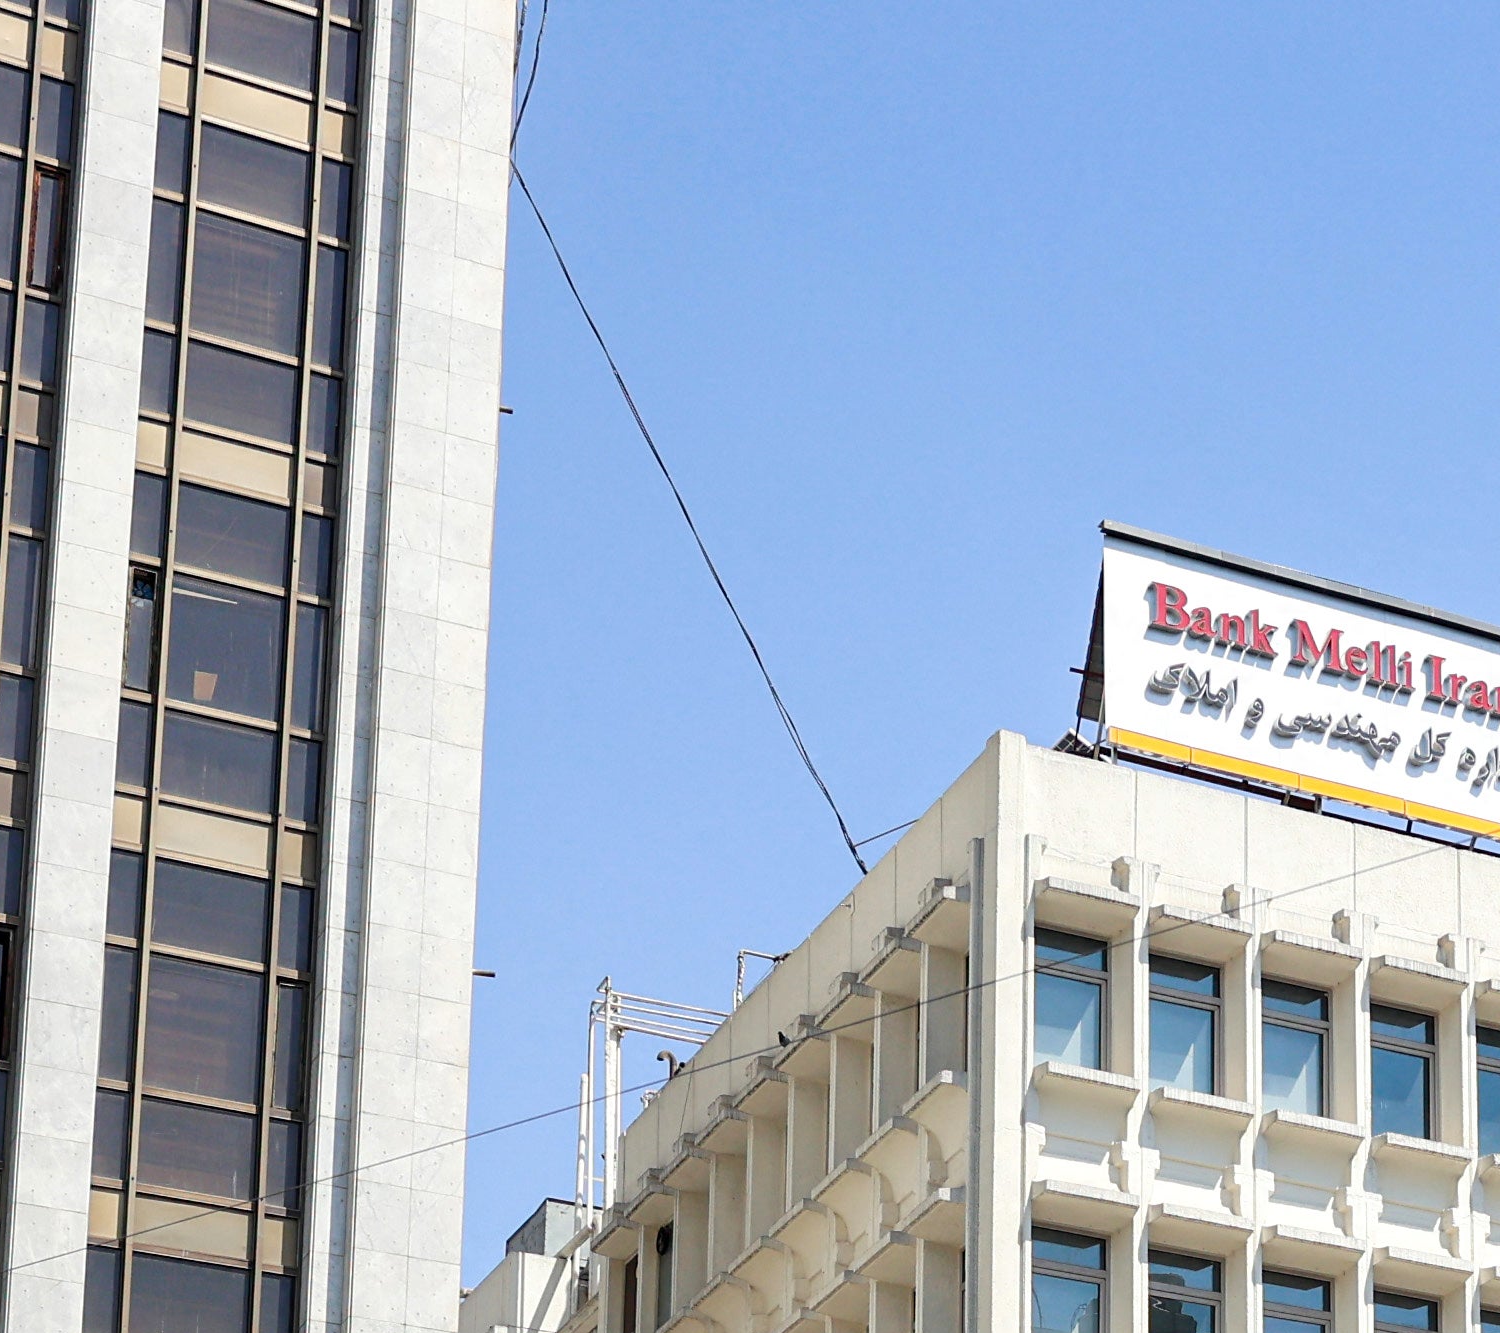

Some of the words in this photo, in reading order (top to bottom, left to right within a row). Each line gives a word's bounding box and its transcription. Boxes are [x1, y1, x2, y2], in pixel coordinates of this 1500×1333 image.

[1148, 581, 1279, 658] Bank
[1287, 619, 1415, 693] Melli
[1150, 663, 1239, 714] املاک
[1246, 698, 1264, 727] و
[1274, 711, 1402, 759] مهندسی
[1412, 727, 1451, 765] کل
